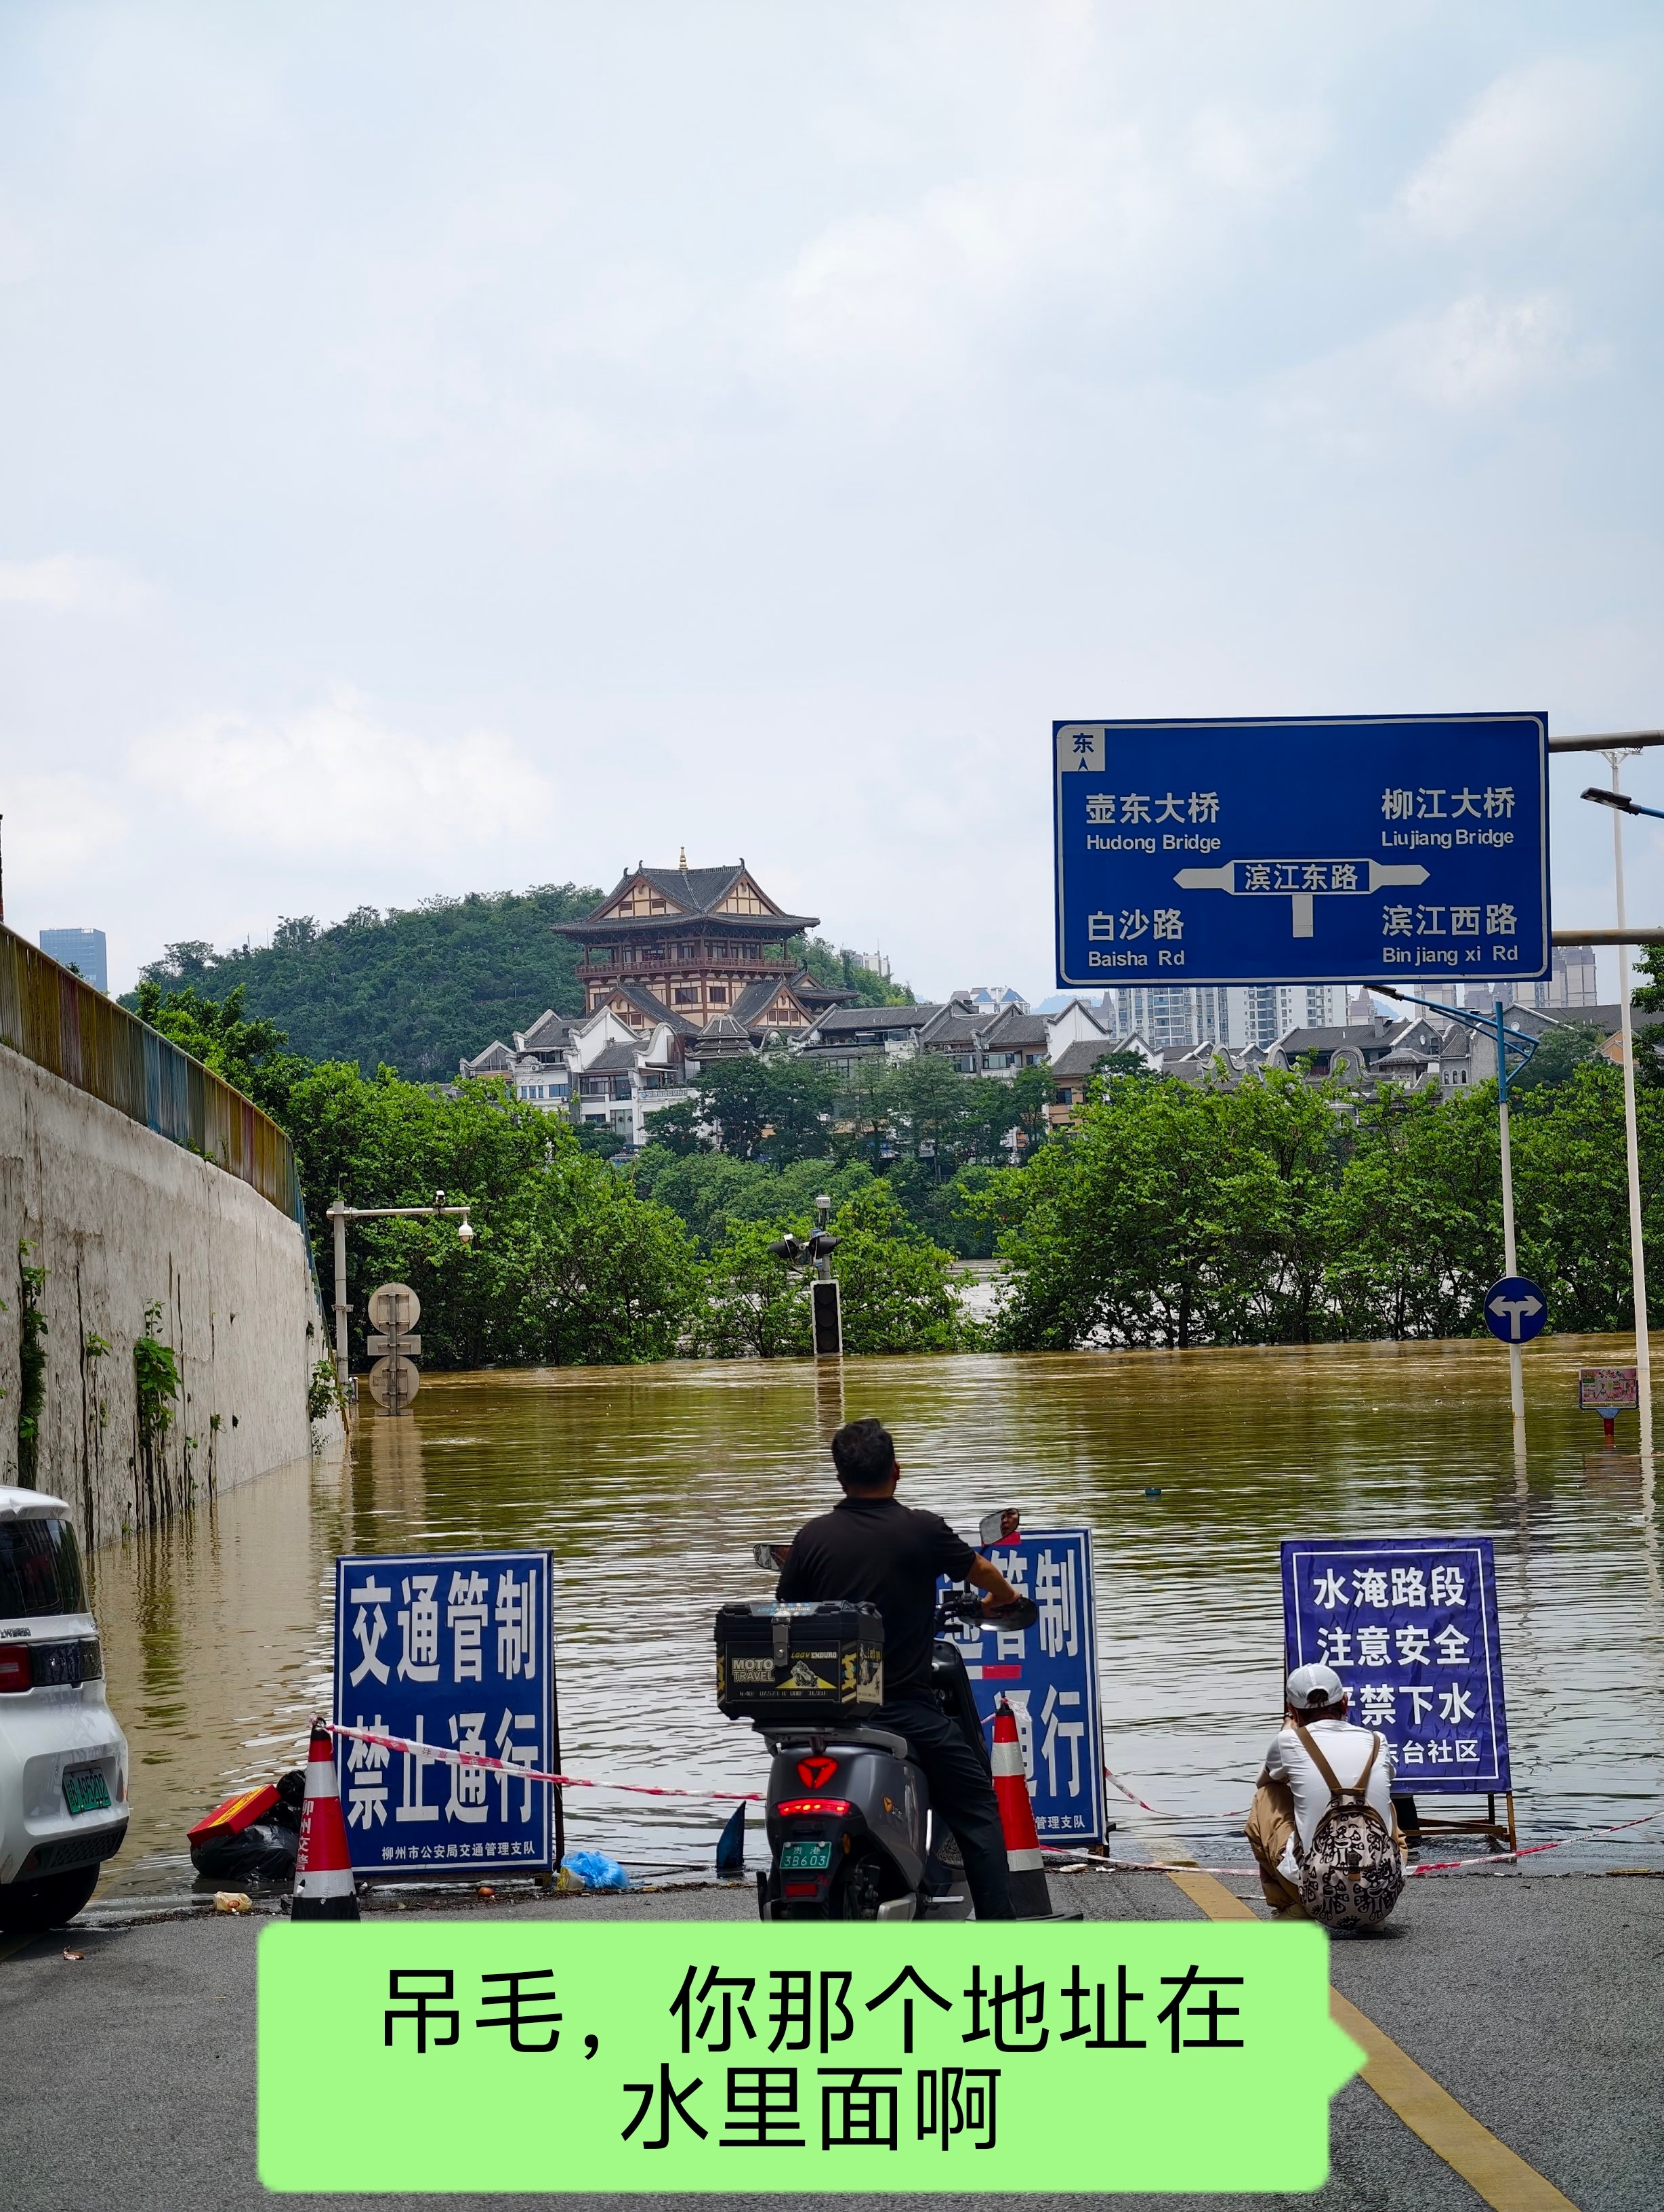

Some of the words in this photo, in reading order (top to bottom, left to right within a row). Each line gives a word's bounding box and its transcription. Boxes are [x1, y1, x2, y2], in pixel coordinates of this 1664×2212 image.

[1073, 733, 1094, 754] 东
[1086, 792, 1220, 824] 壶东大桥
[1381, 786, 1516, 820] 柳江大桥
[1087, 834, 1156, 854] Hudong
[1163, 834, 1221, 854] Bridge
[1381, 830, 1452, 850] Liujiang
[1456, 829, 1514, 848] Bridge
[1245, 863, 1358, 890] 滨江东路
[1088, 907, 1184, 941] 白沙路
[1382, 903, 1518, 937] 滨江西路
[1088, 950, 1148, 966] Baisha
[1159, 950, 1184, 966] Rd
[1465, 946, 1481, 962] xi
[1493, 945, 1518, 961] Rd
[1313, 1565, 1467, 1610] 水淹路段
[350, 1570, 537, 1687] 交通管制
[1316, 1624, 1470, 1666] 注意安全
[732, 1658, 775, 1671] MOTO
[732, 1670, 775, 1682] TRAVEL
[347, 1708, 539, 1830] 禁止通行
[382, 1841, 535, 1861] 柳州市公安局交通管理支队
[784, 1856, 826, 1866] 3B603
